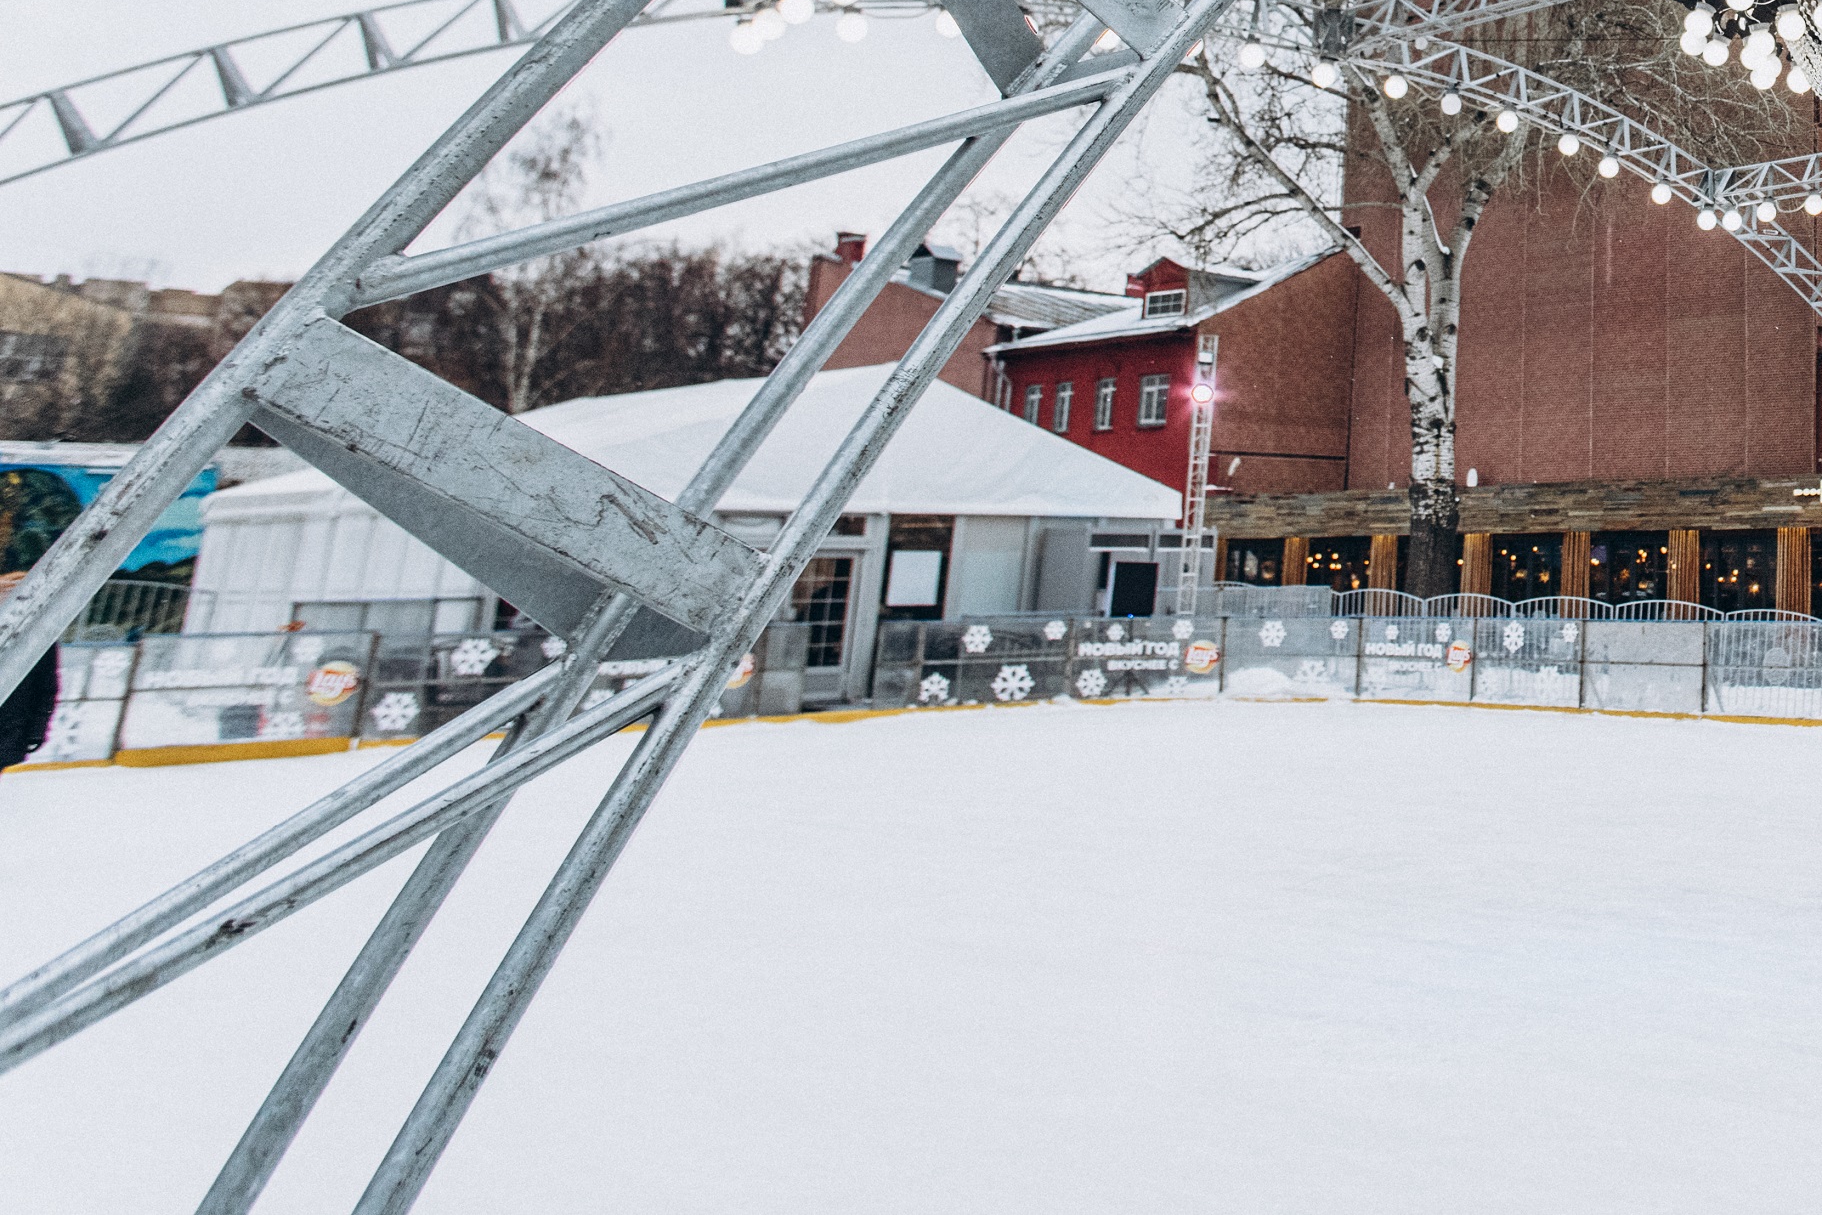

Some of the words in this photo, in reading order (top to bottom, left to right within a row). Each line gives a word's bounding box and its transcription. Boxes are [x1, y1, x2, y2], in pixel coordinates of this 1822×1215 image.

[1078, 640, 1142, 657] НОВЫЙ
[1143, 642, 1180, 657] ГОД
[1365, 640, 1414, 656] НОВЫЙ
[1417, 643, 1442, 659] ГОД
